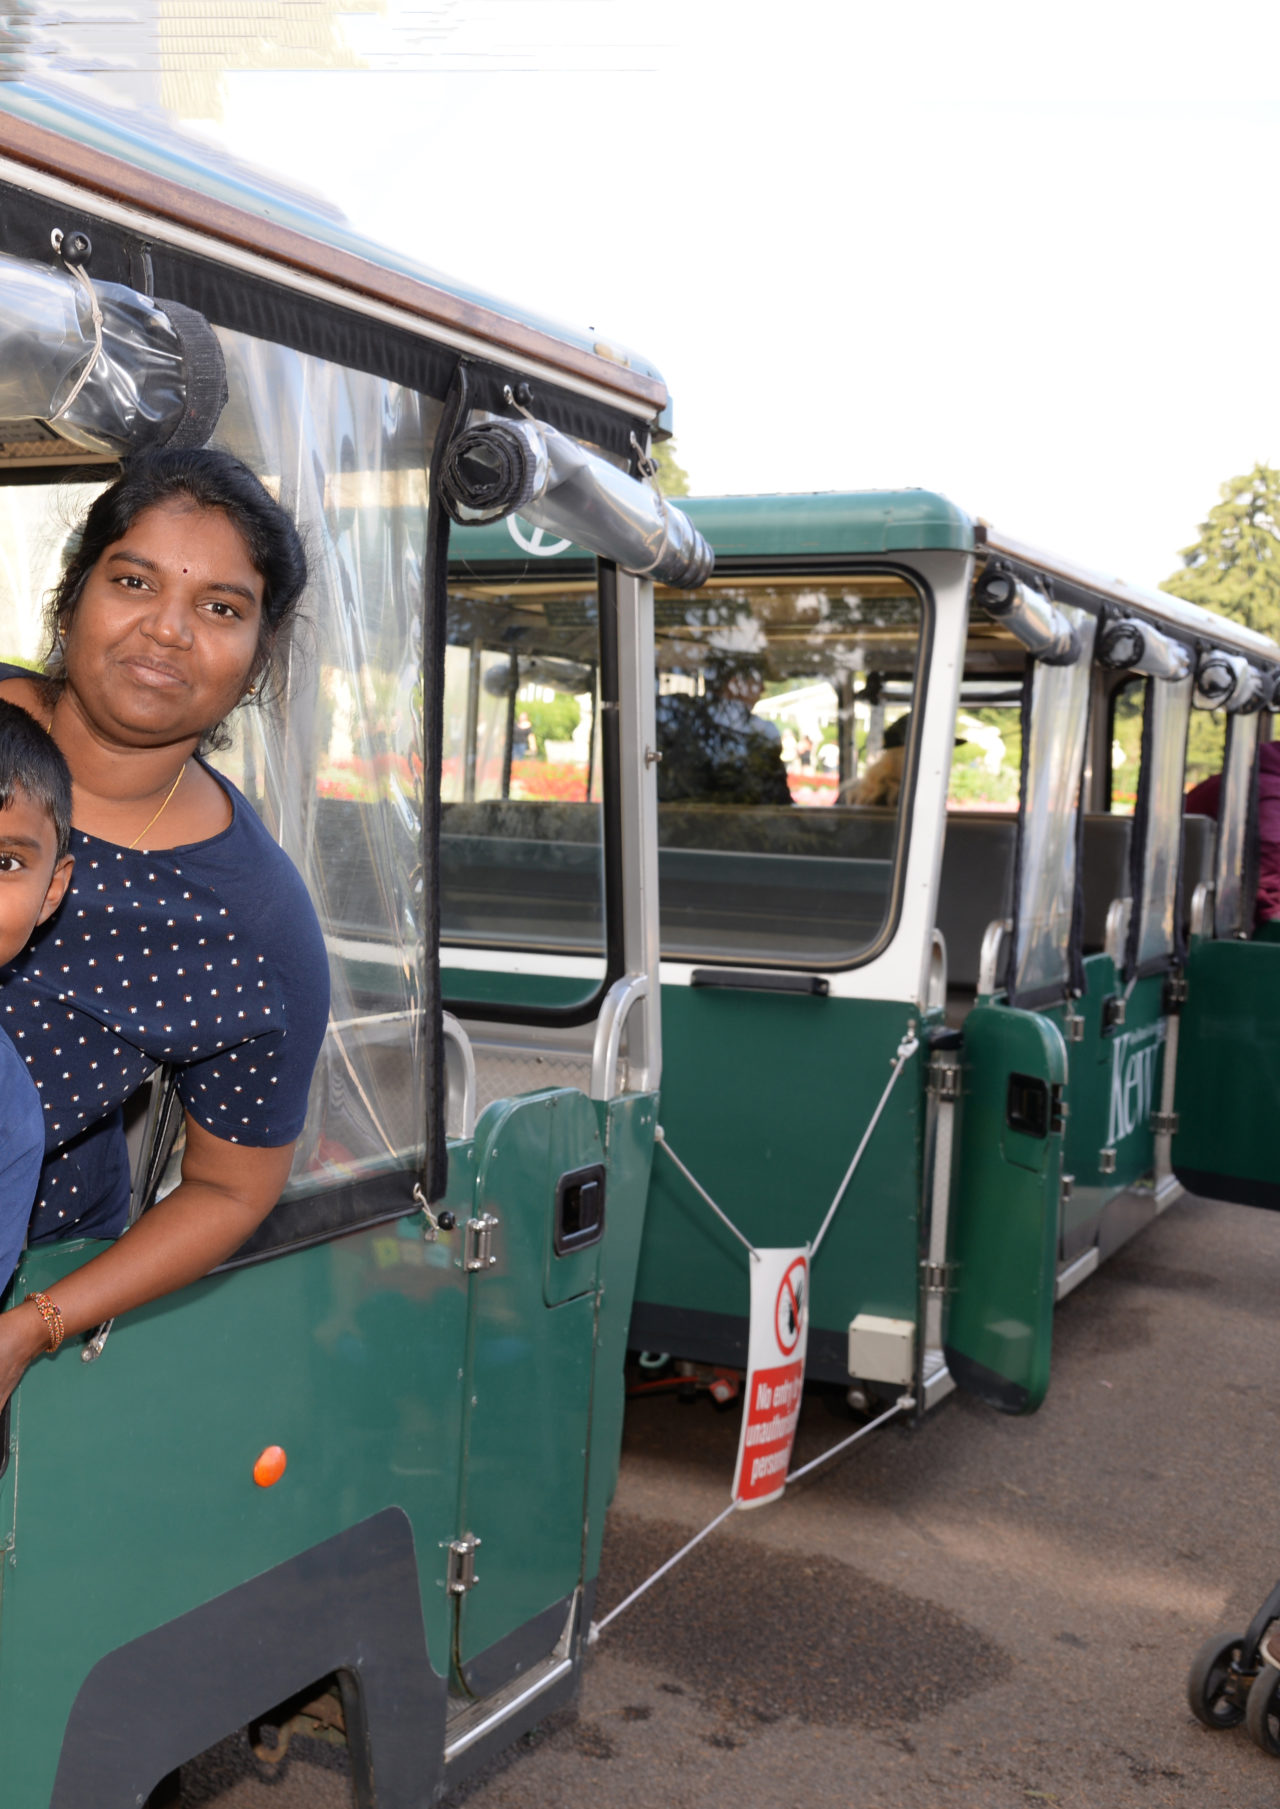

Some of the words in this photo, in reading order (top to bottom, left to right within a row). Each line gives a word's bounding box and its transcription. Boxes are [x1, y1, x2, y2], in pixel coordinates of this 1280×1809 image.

[755, 1382, 773, 1412] No
[746, 1404, 799, 1447] unauthor
[749, 1443, 791, 1487] person
